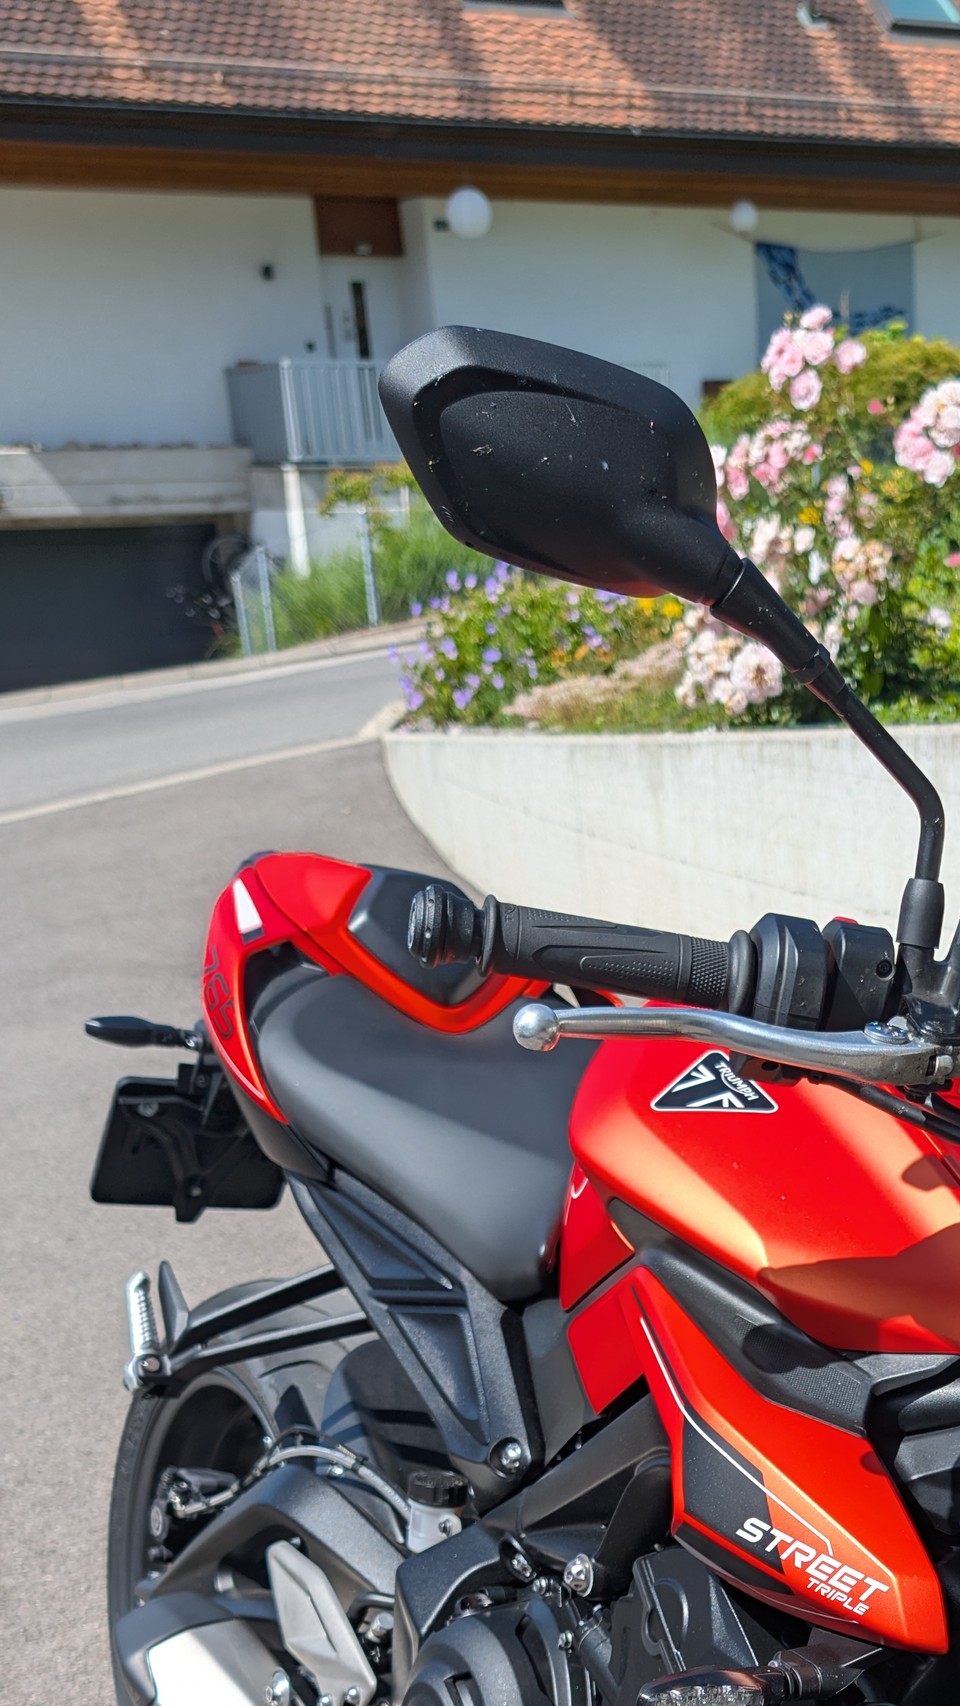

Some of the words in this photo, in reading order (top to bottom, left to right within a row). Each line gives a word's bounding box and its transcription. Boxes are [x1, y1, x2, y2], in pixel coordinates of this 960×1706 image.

[204, 944, 234, 1039] 765
[714, 1061, 759, 1101] TRIUMPH
[736, 1517, 890, 1601] STREET
[806, 1577, 870, 1616] TRIPLE
